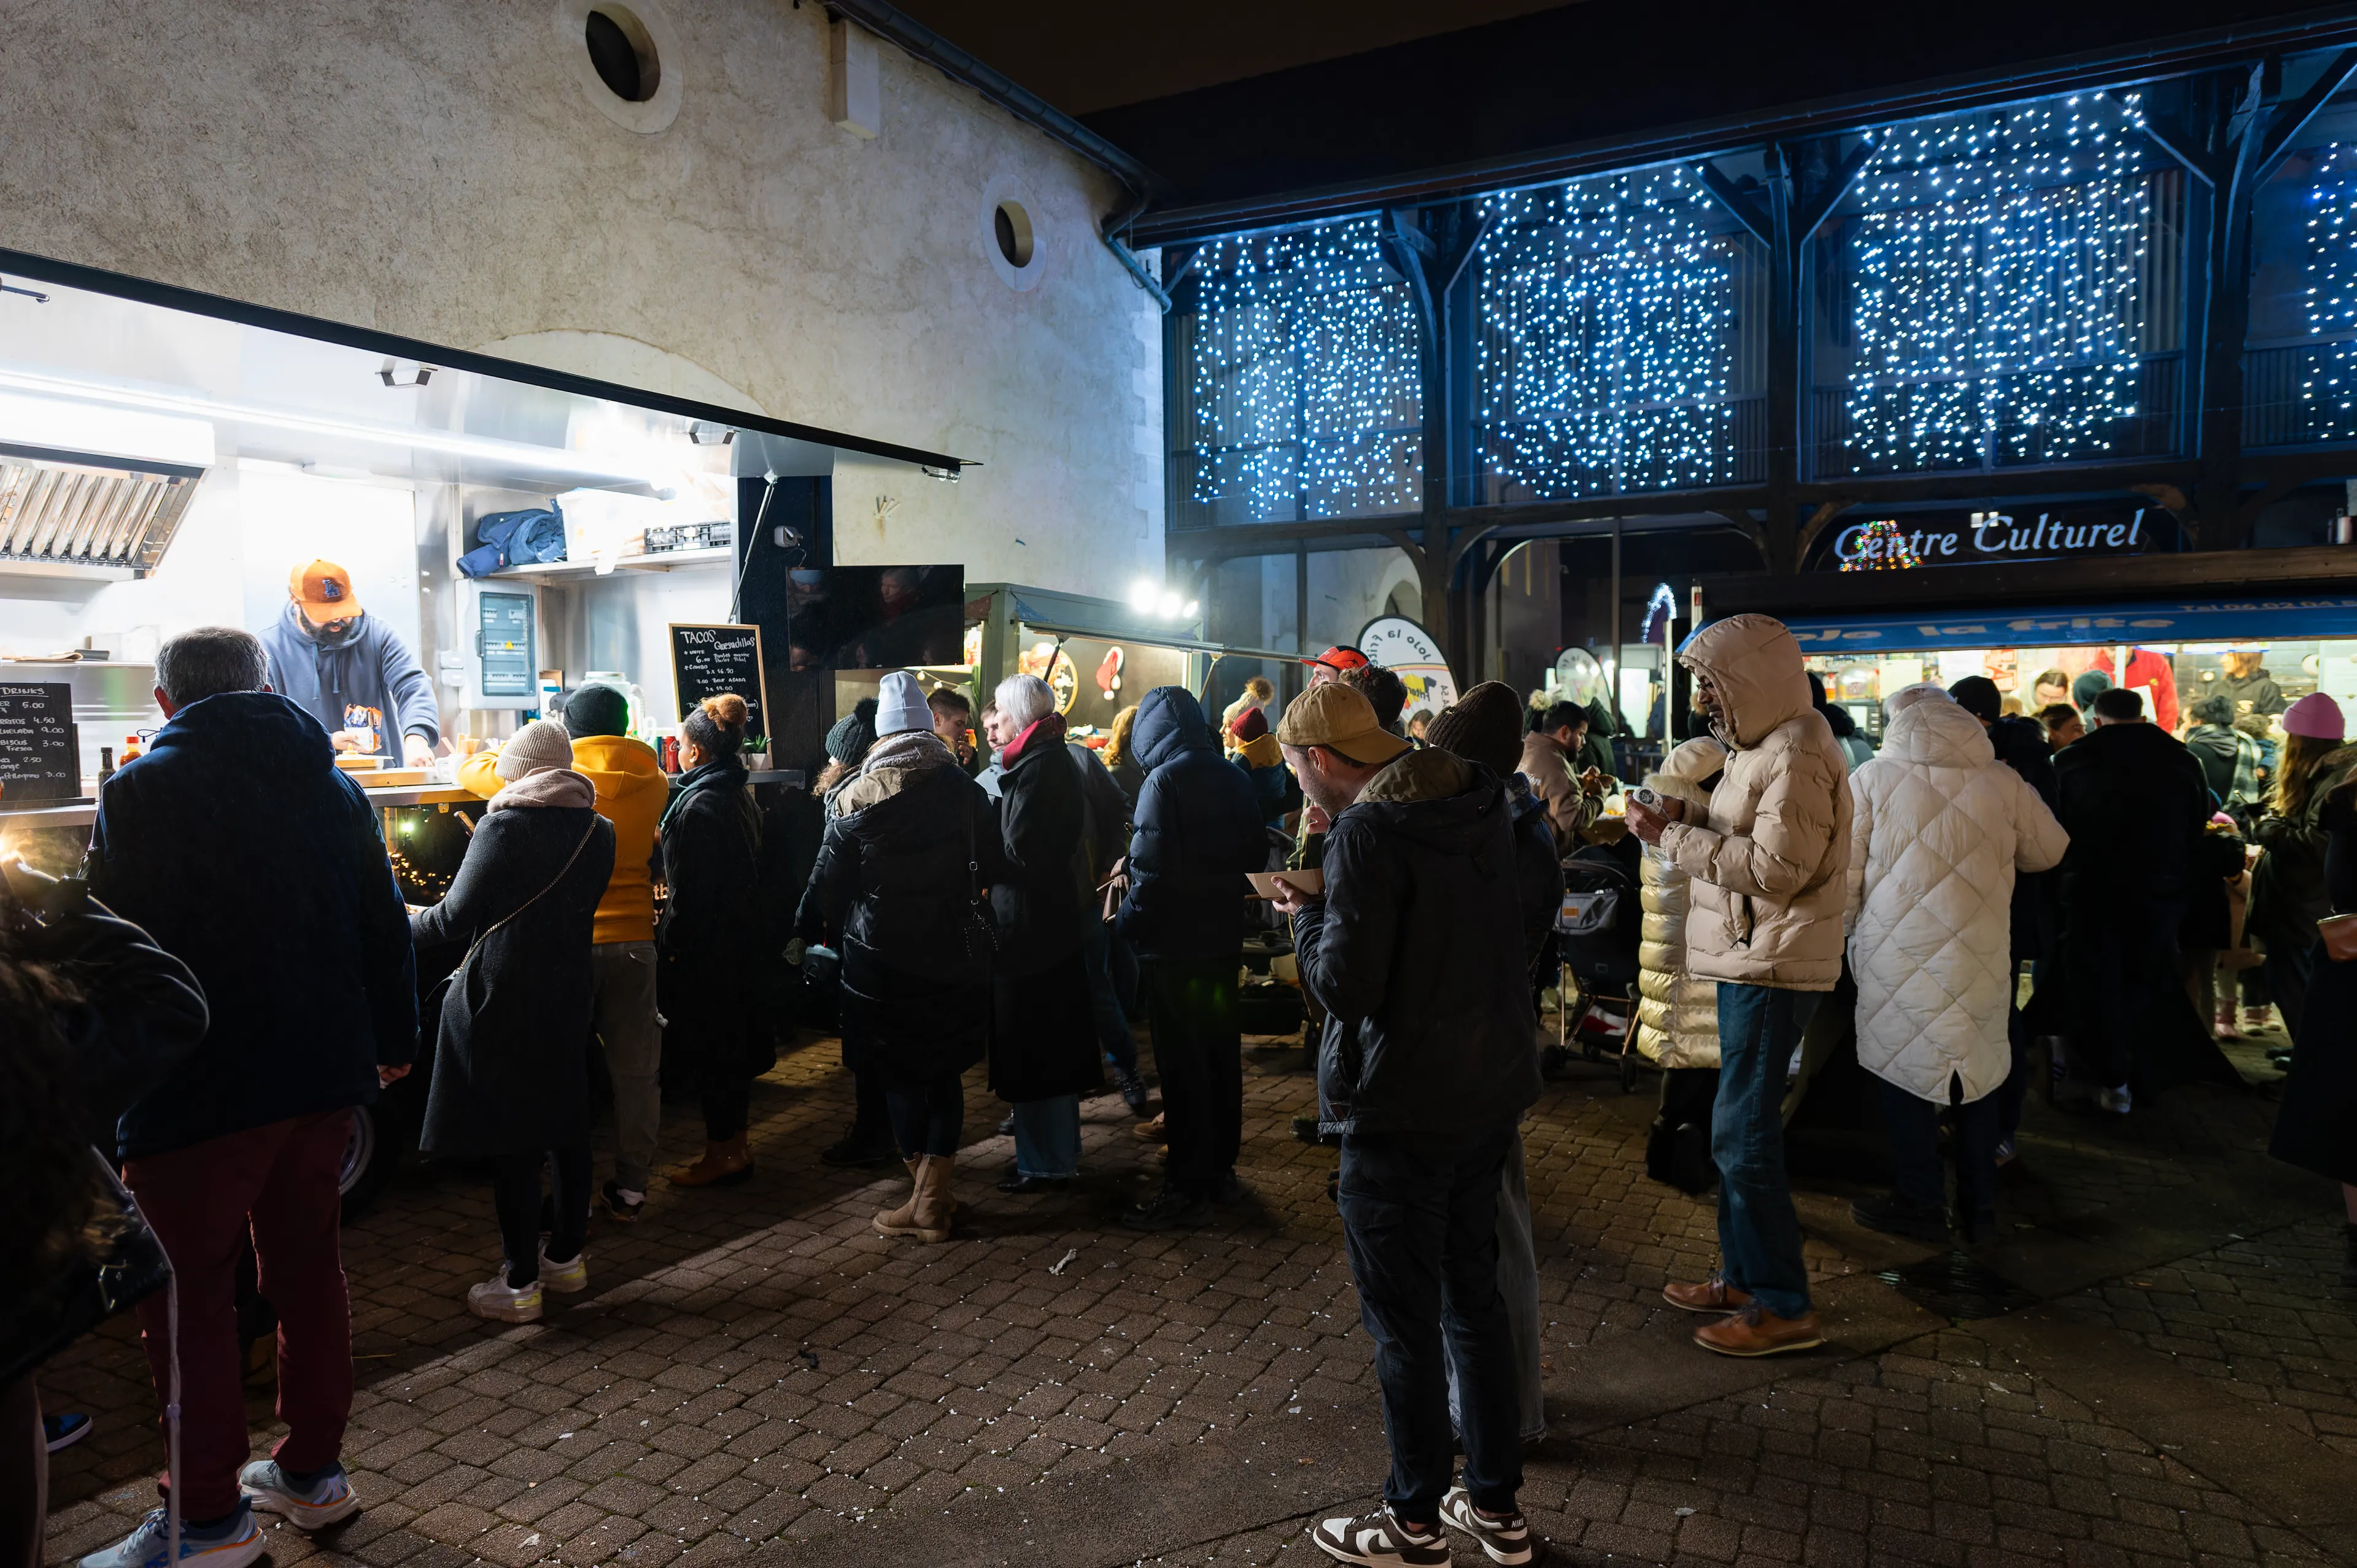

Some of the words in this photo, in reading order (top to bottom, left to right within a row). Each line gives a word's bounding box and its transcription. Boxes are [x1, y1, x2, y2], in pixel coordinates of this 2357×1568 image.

[1834, 525, 1958, 558] Centre
[1974, 508, 2145, 552] Culturel
[322, 579, 341, 598] LA
[680, 630, 716, 644] TACOS
[1790, 629, 1883, 641] ojo
[1918, 625, 1987, 636] la
[2007, 618, 2175, 631] frite
[714, 637, 755, 651] Quesadillas
[1511, 1517, 1525, 1528] NIKE
